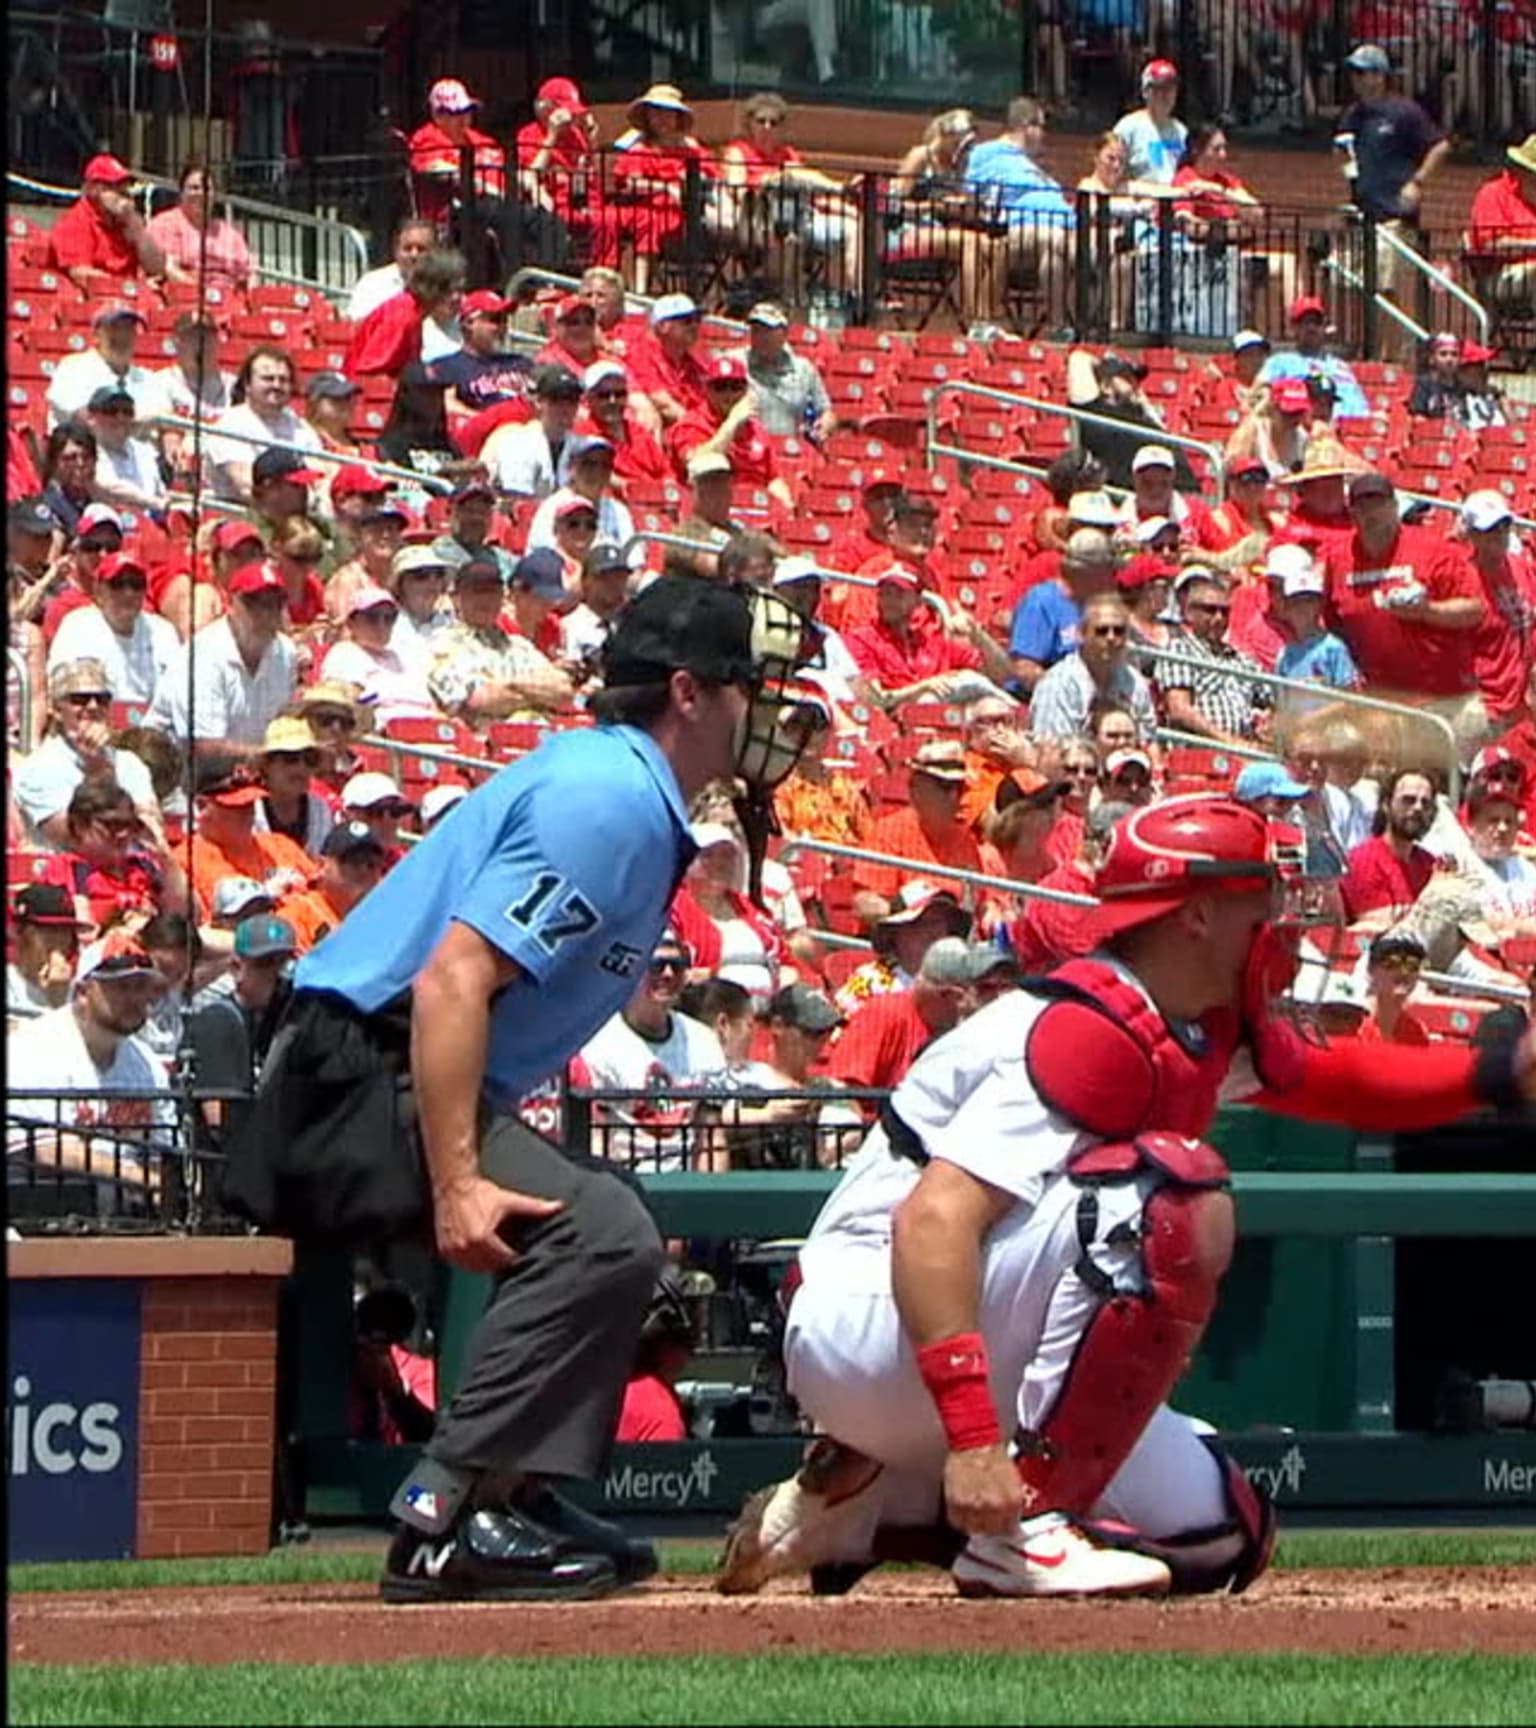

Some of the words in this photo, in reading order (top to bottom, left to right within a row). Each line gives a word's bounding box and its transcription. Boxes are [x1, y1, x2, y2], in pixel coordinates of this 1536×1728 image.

[504, 871, 602, 956] 17
[12, 1376, 122, 1475] ics
[605, 1466, 695, 1507] Mercy
